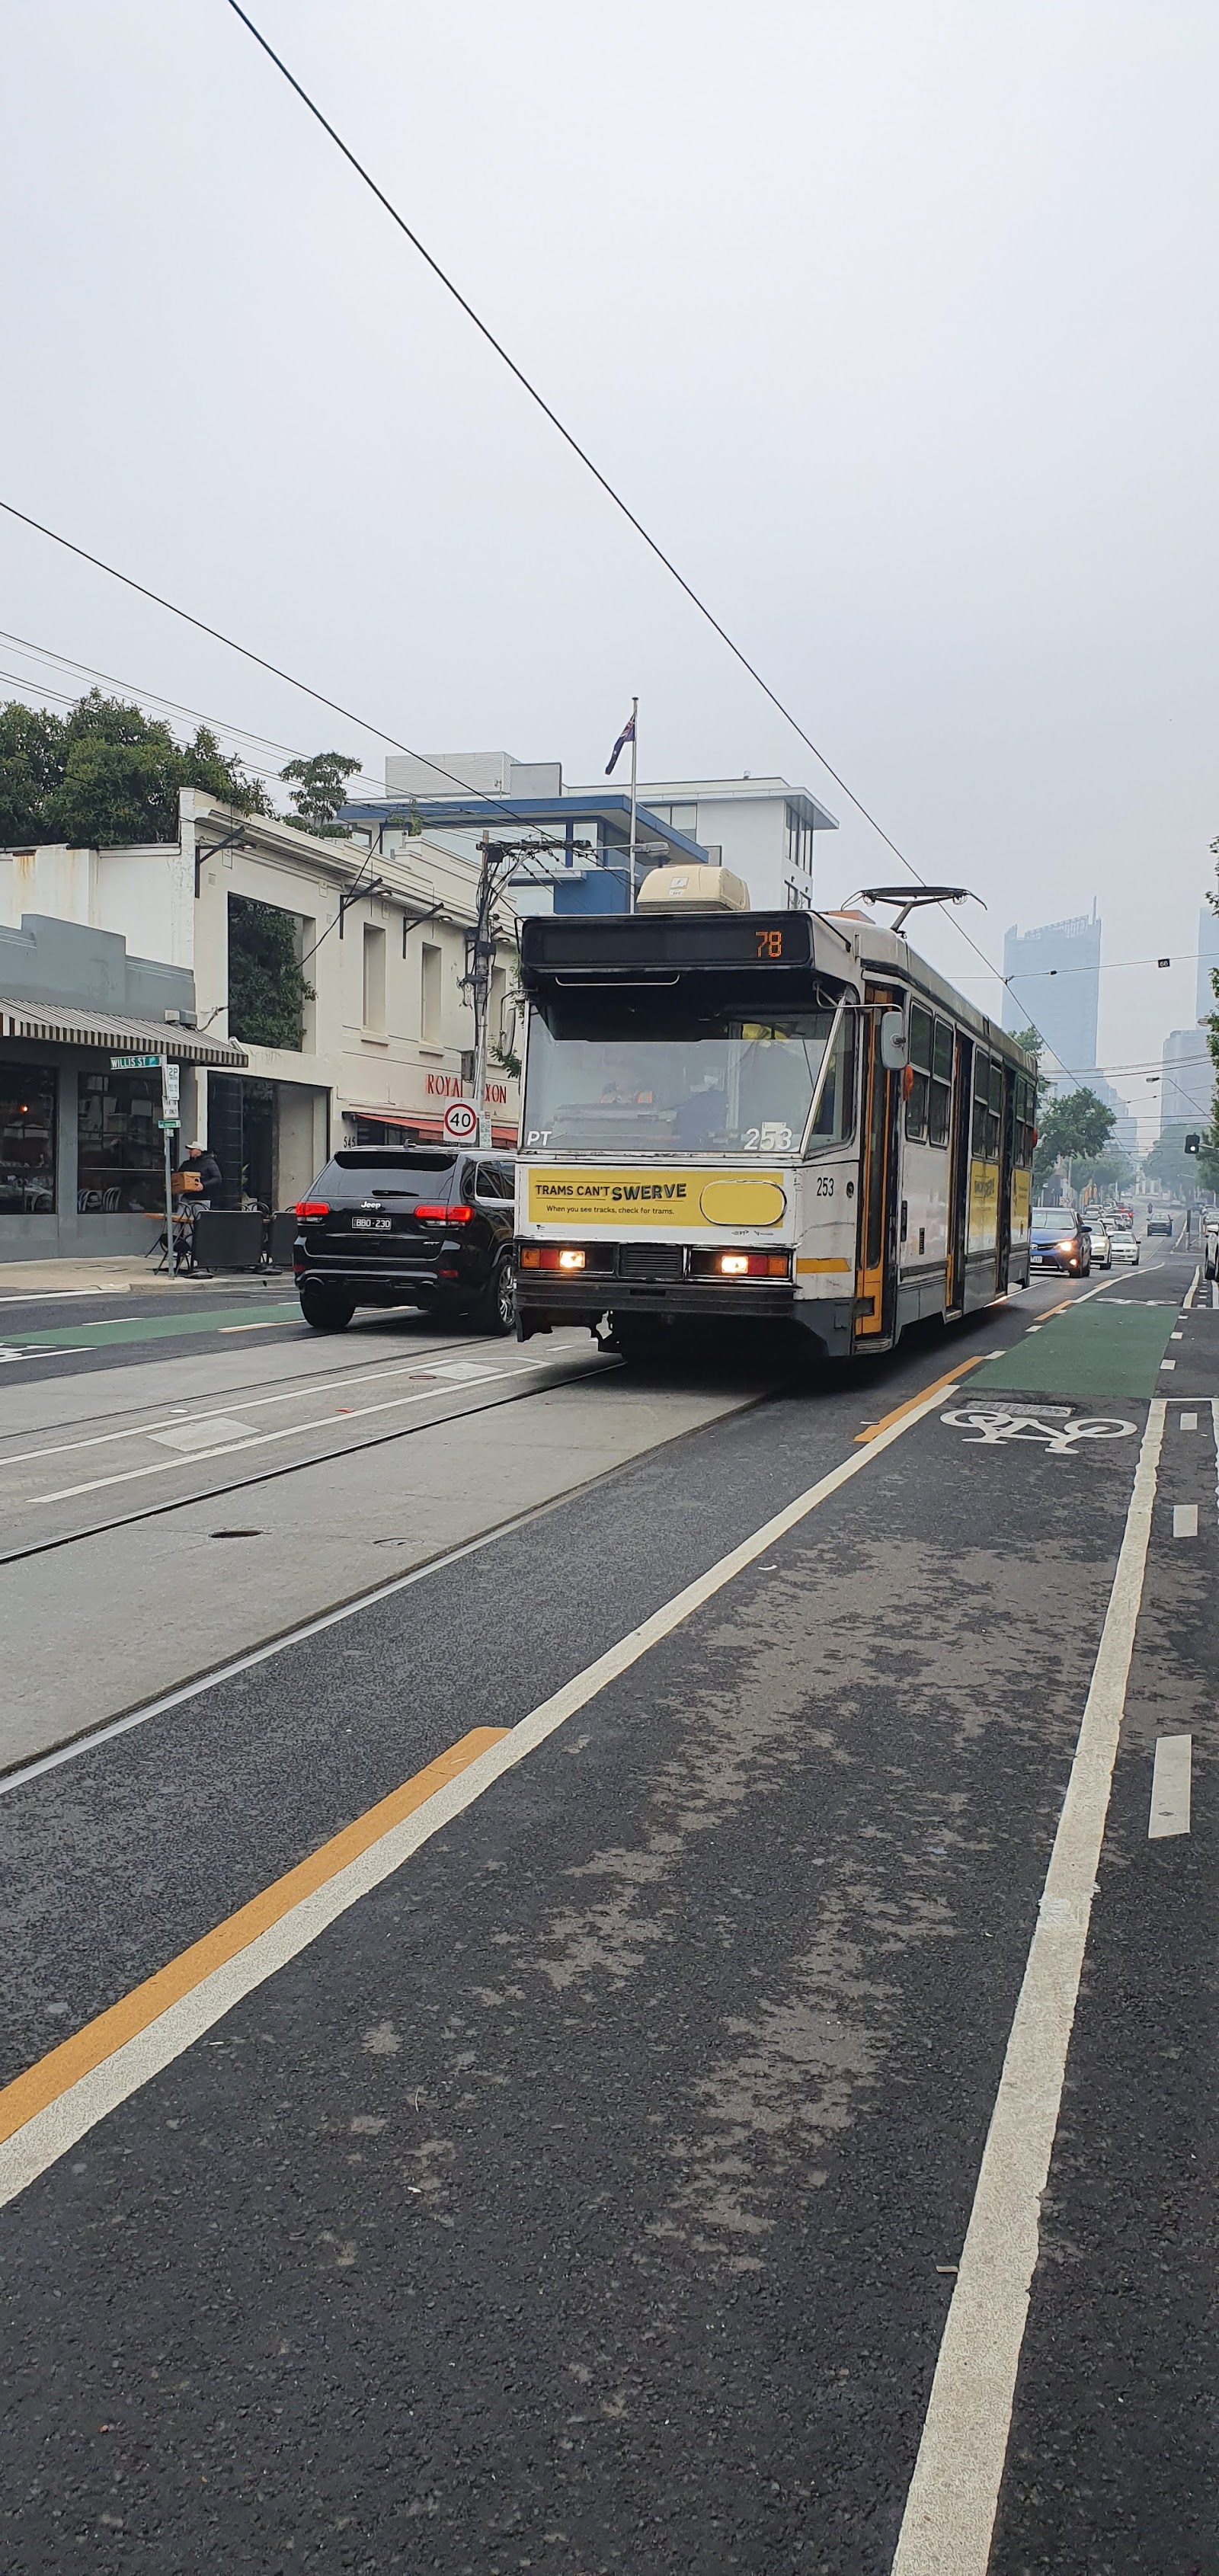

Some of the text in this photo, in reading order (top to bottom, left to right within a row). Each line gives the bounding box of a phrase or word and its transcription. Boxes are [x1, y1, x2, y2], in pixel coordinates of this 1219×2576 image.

[755, 930, 782, 958] 78
[110, 1057, 146, 1068] WILLIS ST
[168, 1067, 178, 1077] 2P
[483, 1083, 507, 1104] XON
[450, 1112, 471, 1128] 40
[343, 1136, 356, 1149] 545
[526, 1131, 552, 1146] PT
[744, 1128, 792, 1150] 253
[536, 1182, 686, 1201] TRAMS CAN'T SWERVE
[816, 1177, 834, 1196] 253
[360, 1202, 381, 1210] Jeep
